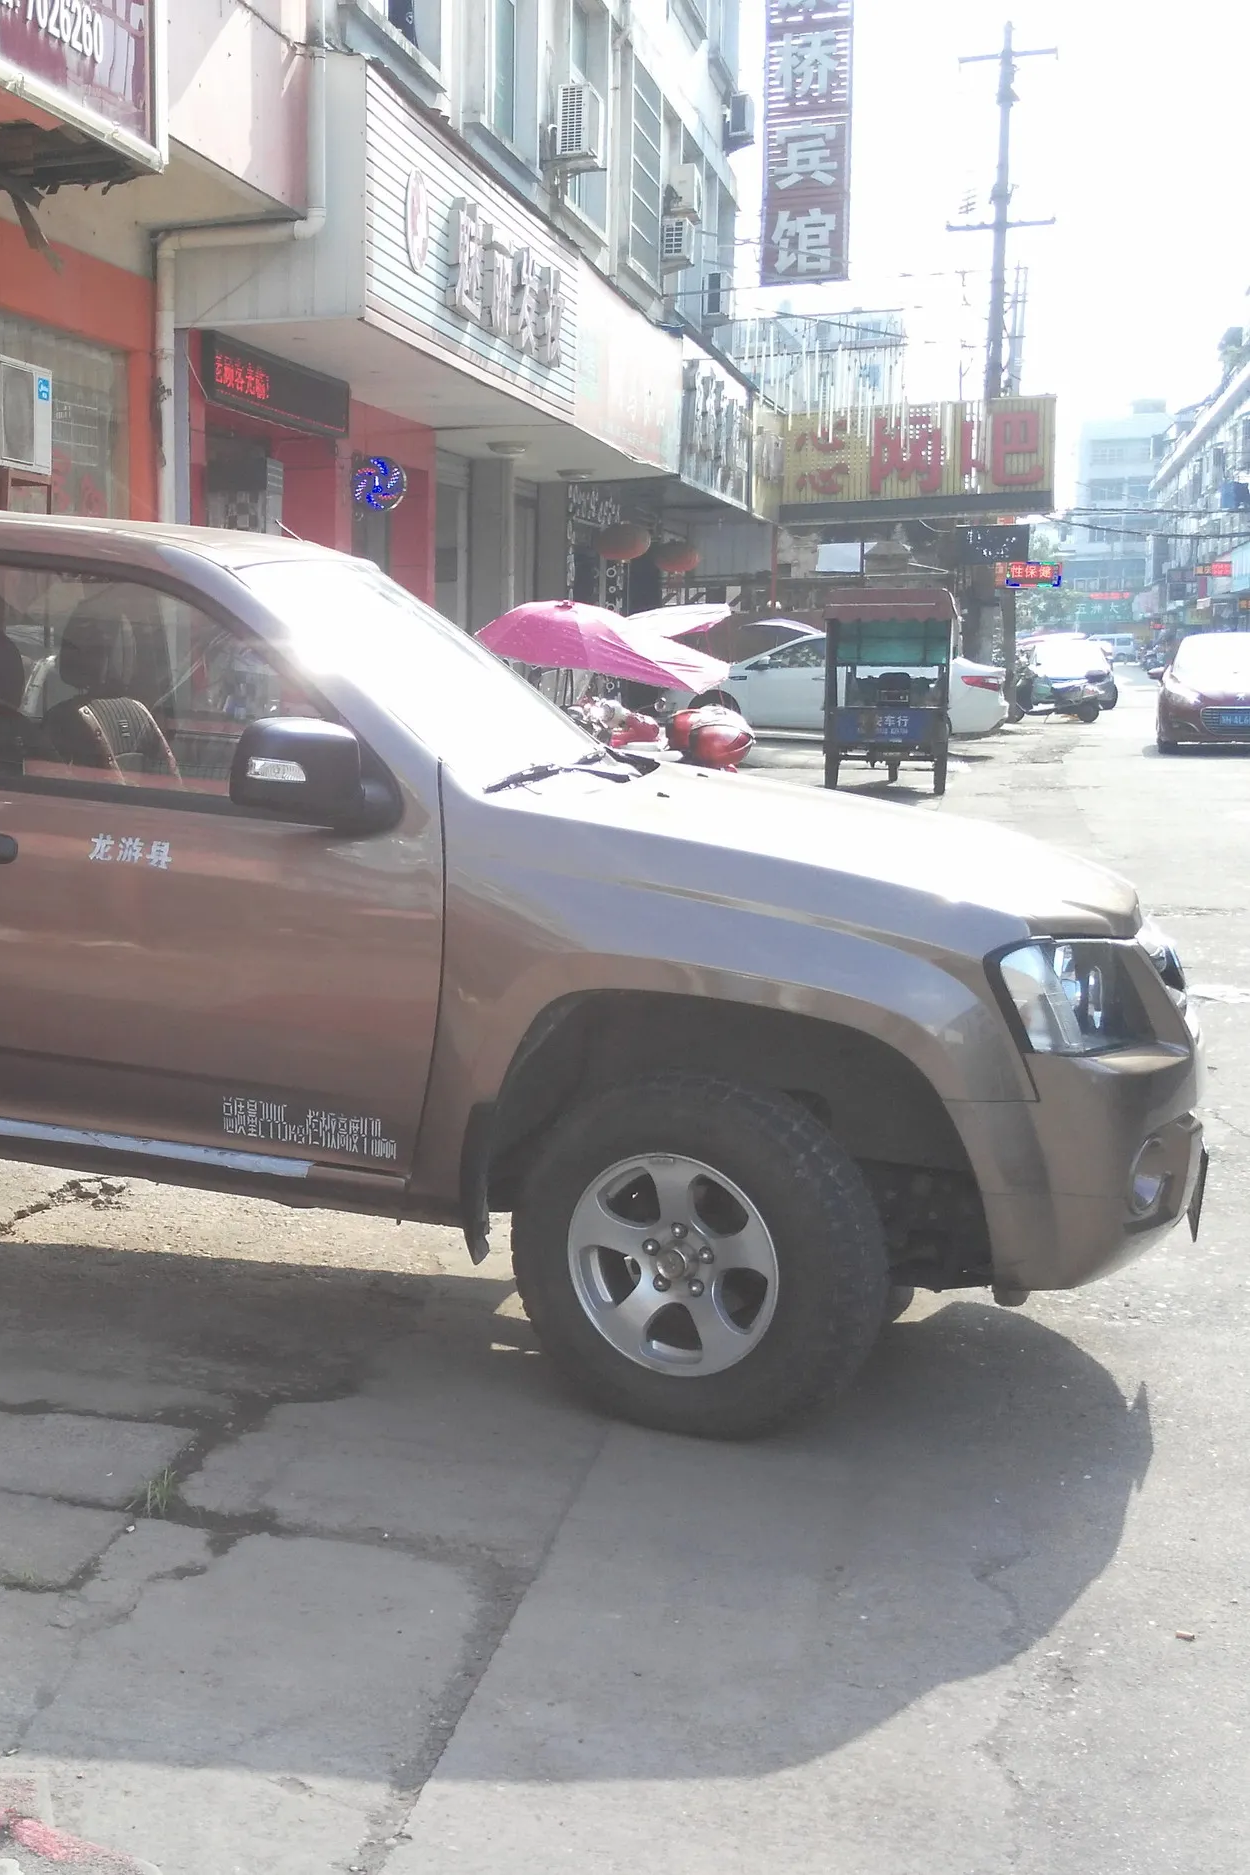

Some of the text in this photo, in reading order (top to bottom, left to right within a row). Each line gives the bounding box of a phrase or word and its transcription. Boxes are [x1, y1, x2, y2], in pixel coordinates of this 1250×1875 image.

[771, 0, 840, 275] 桥宾馆
[870, 410, 1045, 494] 网吧
[1010, 565, 1053, 579] 性保健
[88, 833, 173, 870] 龙游县
